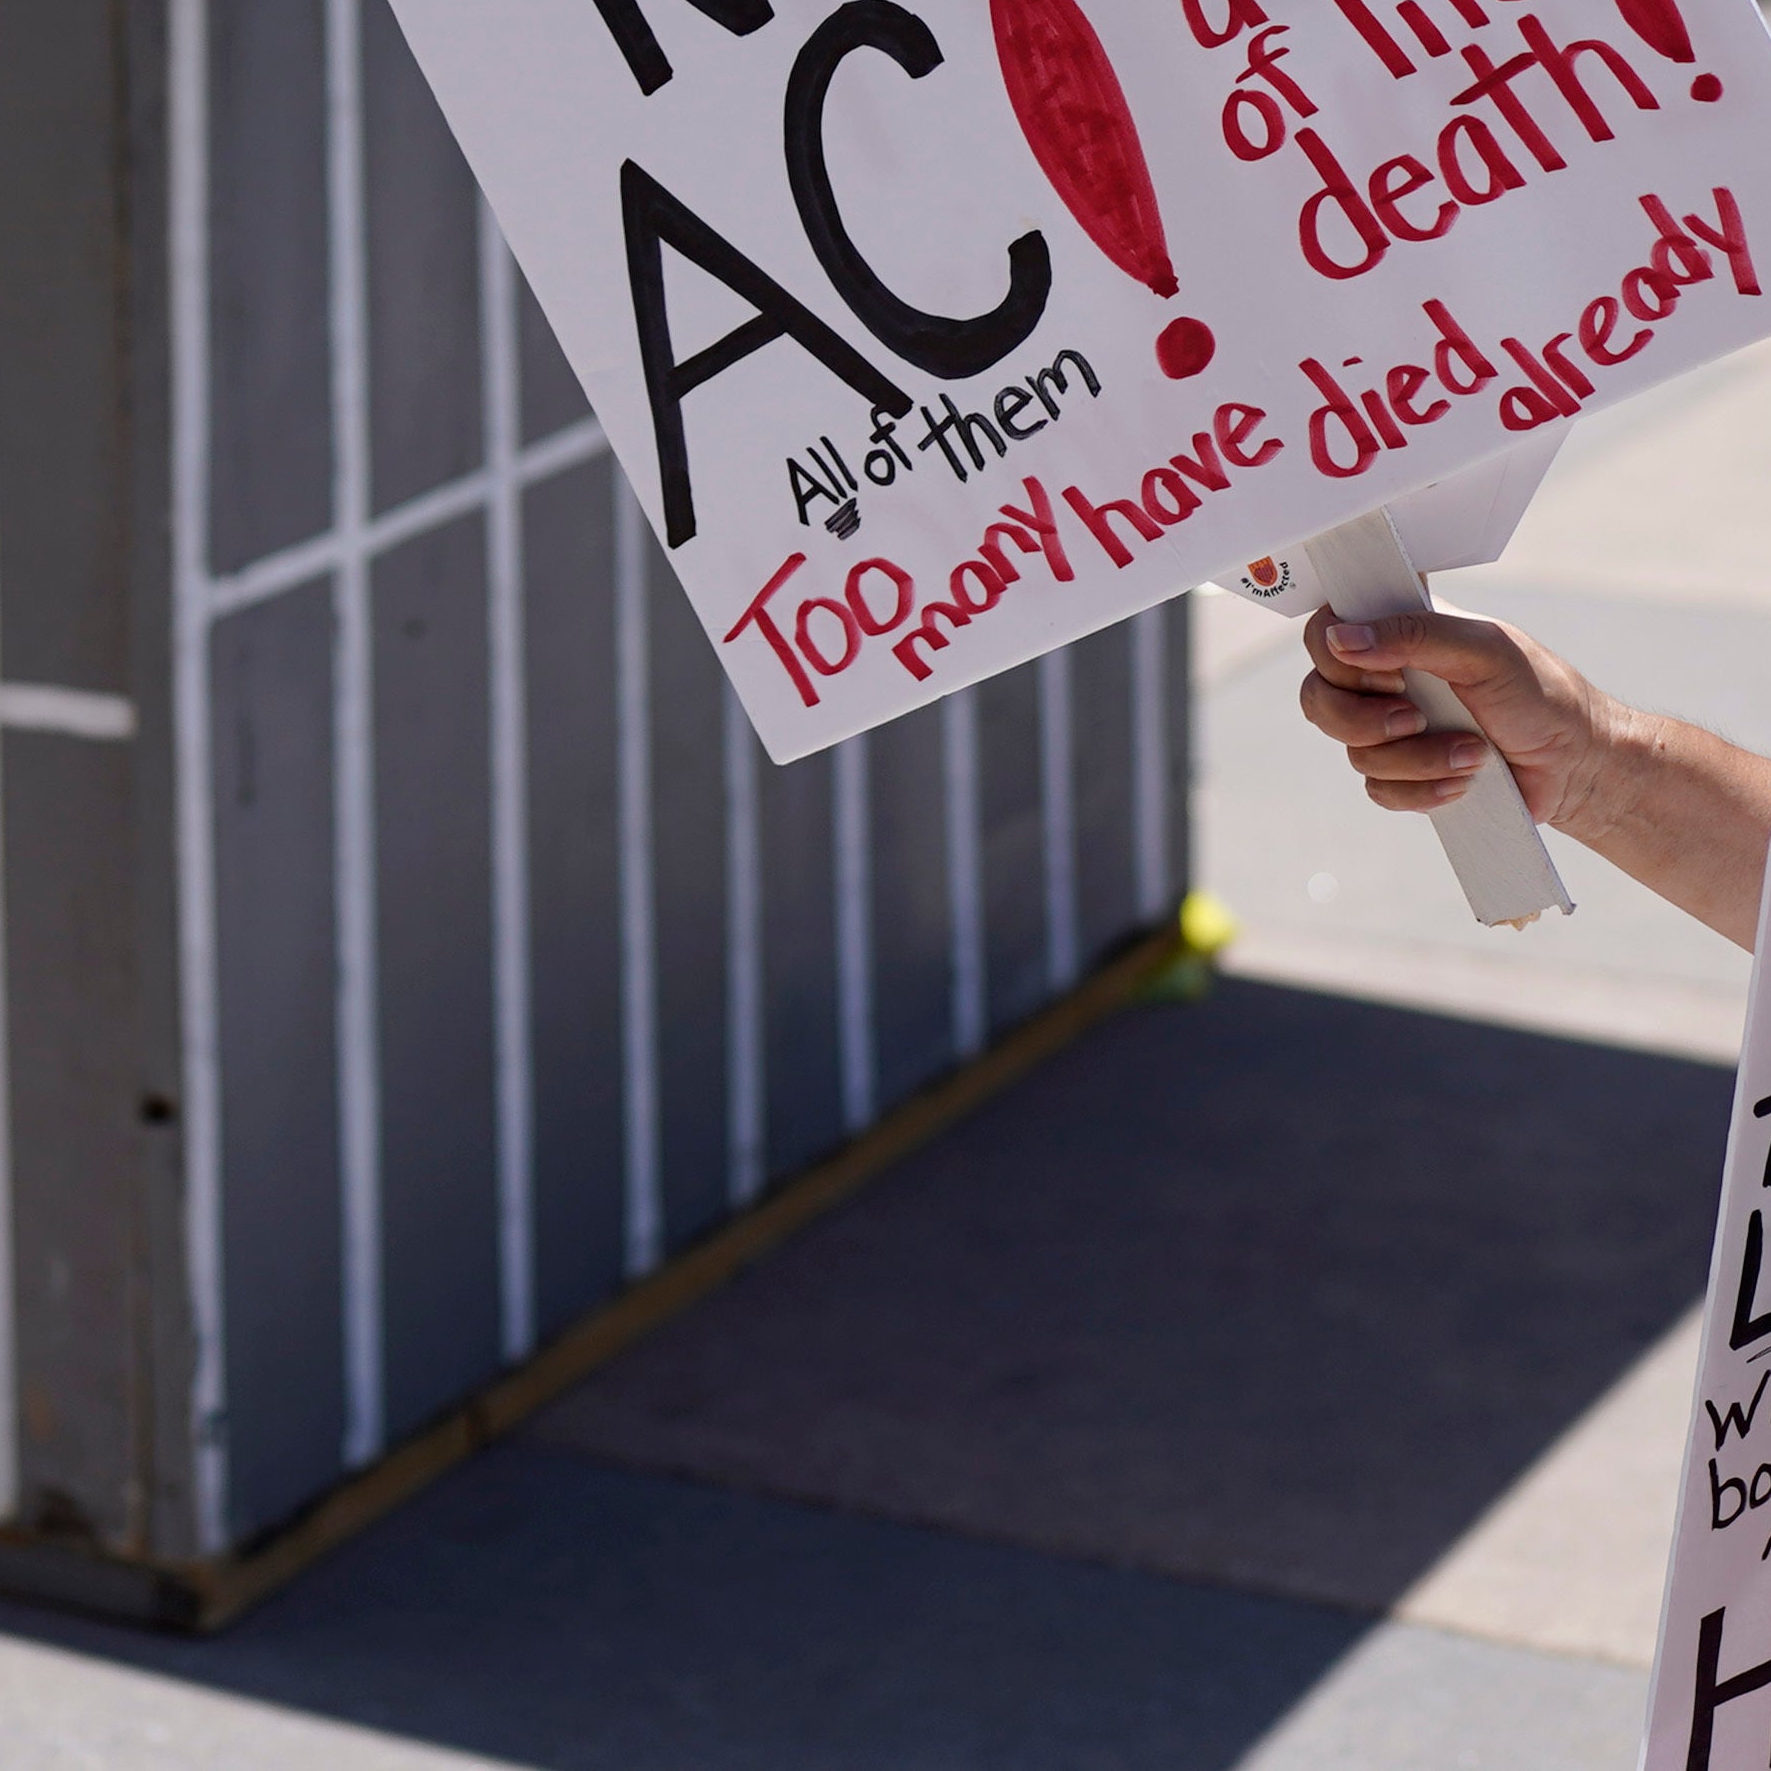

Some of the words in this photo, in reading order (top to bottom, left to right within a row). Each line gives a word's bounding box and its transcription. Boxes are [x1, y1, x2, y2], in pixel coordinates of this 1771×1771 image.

[1222, 26, 1319, 161] of
[785, 434, 861, 529] All
[863, 401, 914, 487] of
[918, 348, 1100, 482] them
[893, 476, 1074, 681] many
[1064, 401, 1284, 569] have
[1300, 300, 1499, 479] died
[1498, 186, 1763, 431] already
